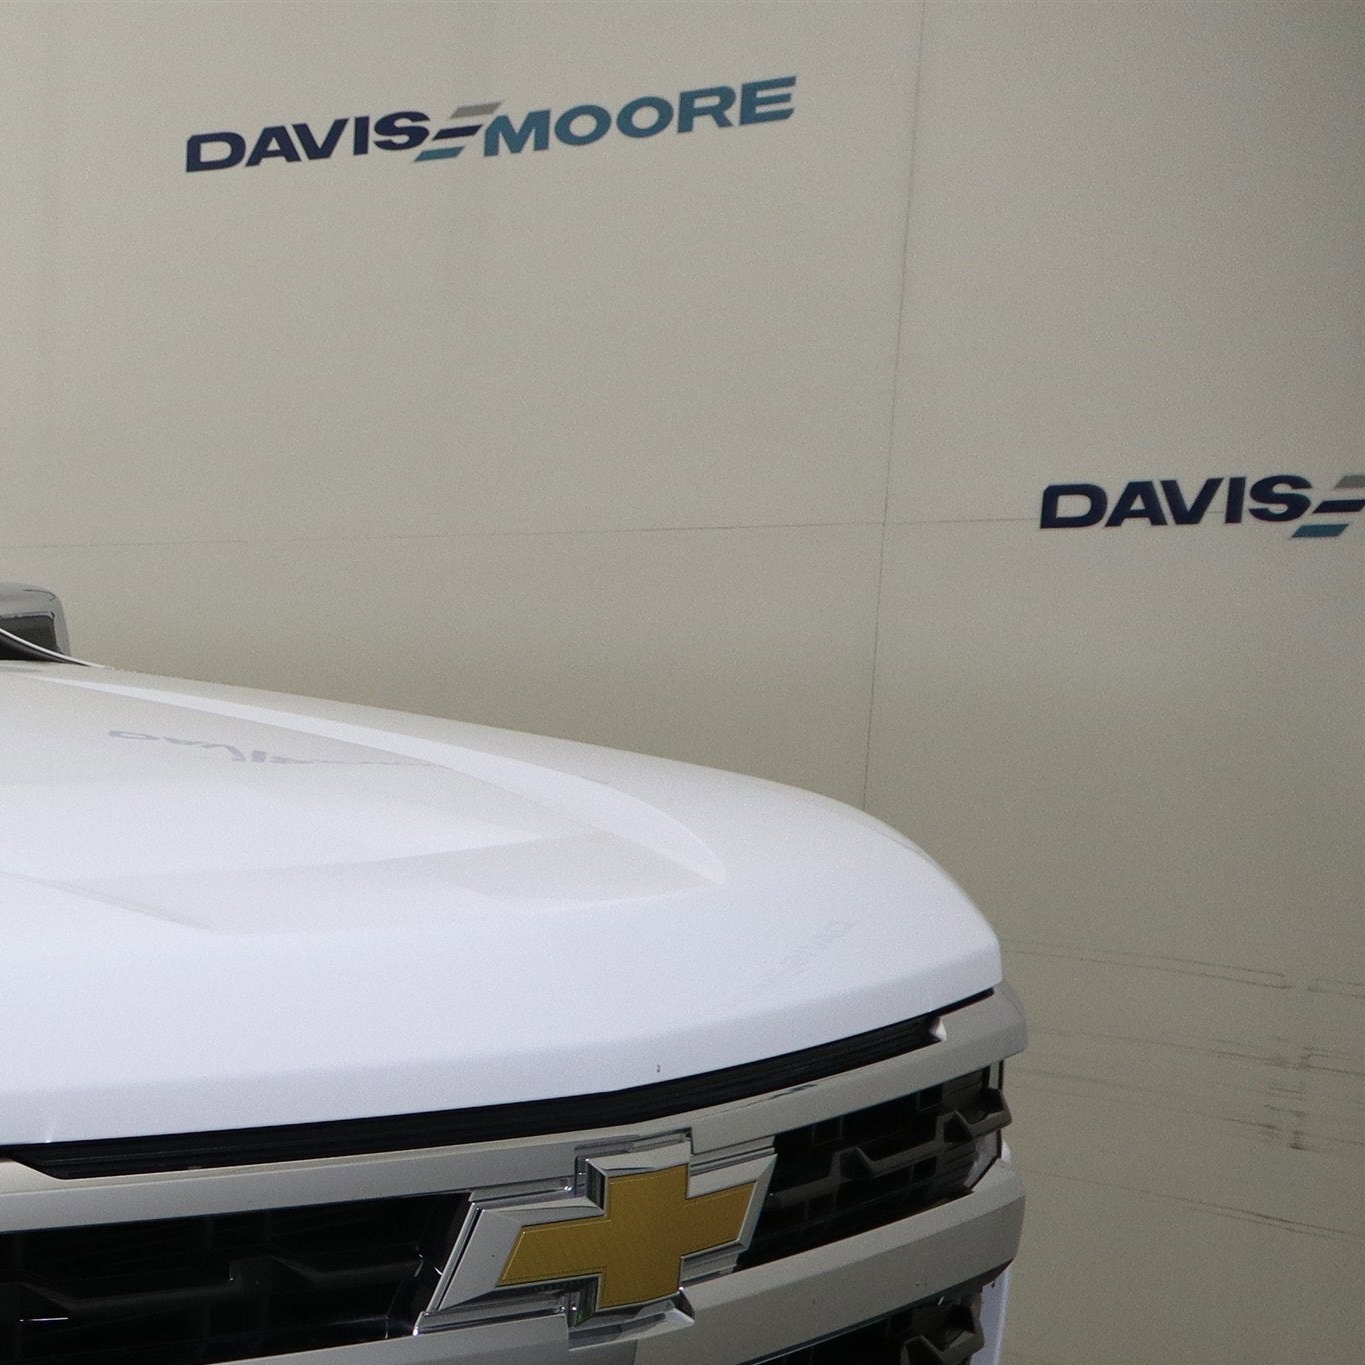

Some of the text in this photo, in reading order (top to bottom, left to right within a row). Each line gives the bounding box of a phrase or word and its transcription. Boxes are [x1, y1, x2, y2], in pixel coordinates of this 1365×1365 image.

[185, 76, 797, 173] DAVIS MOORE
[1039, 474, 1313, 530] DAVIS
